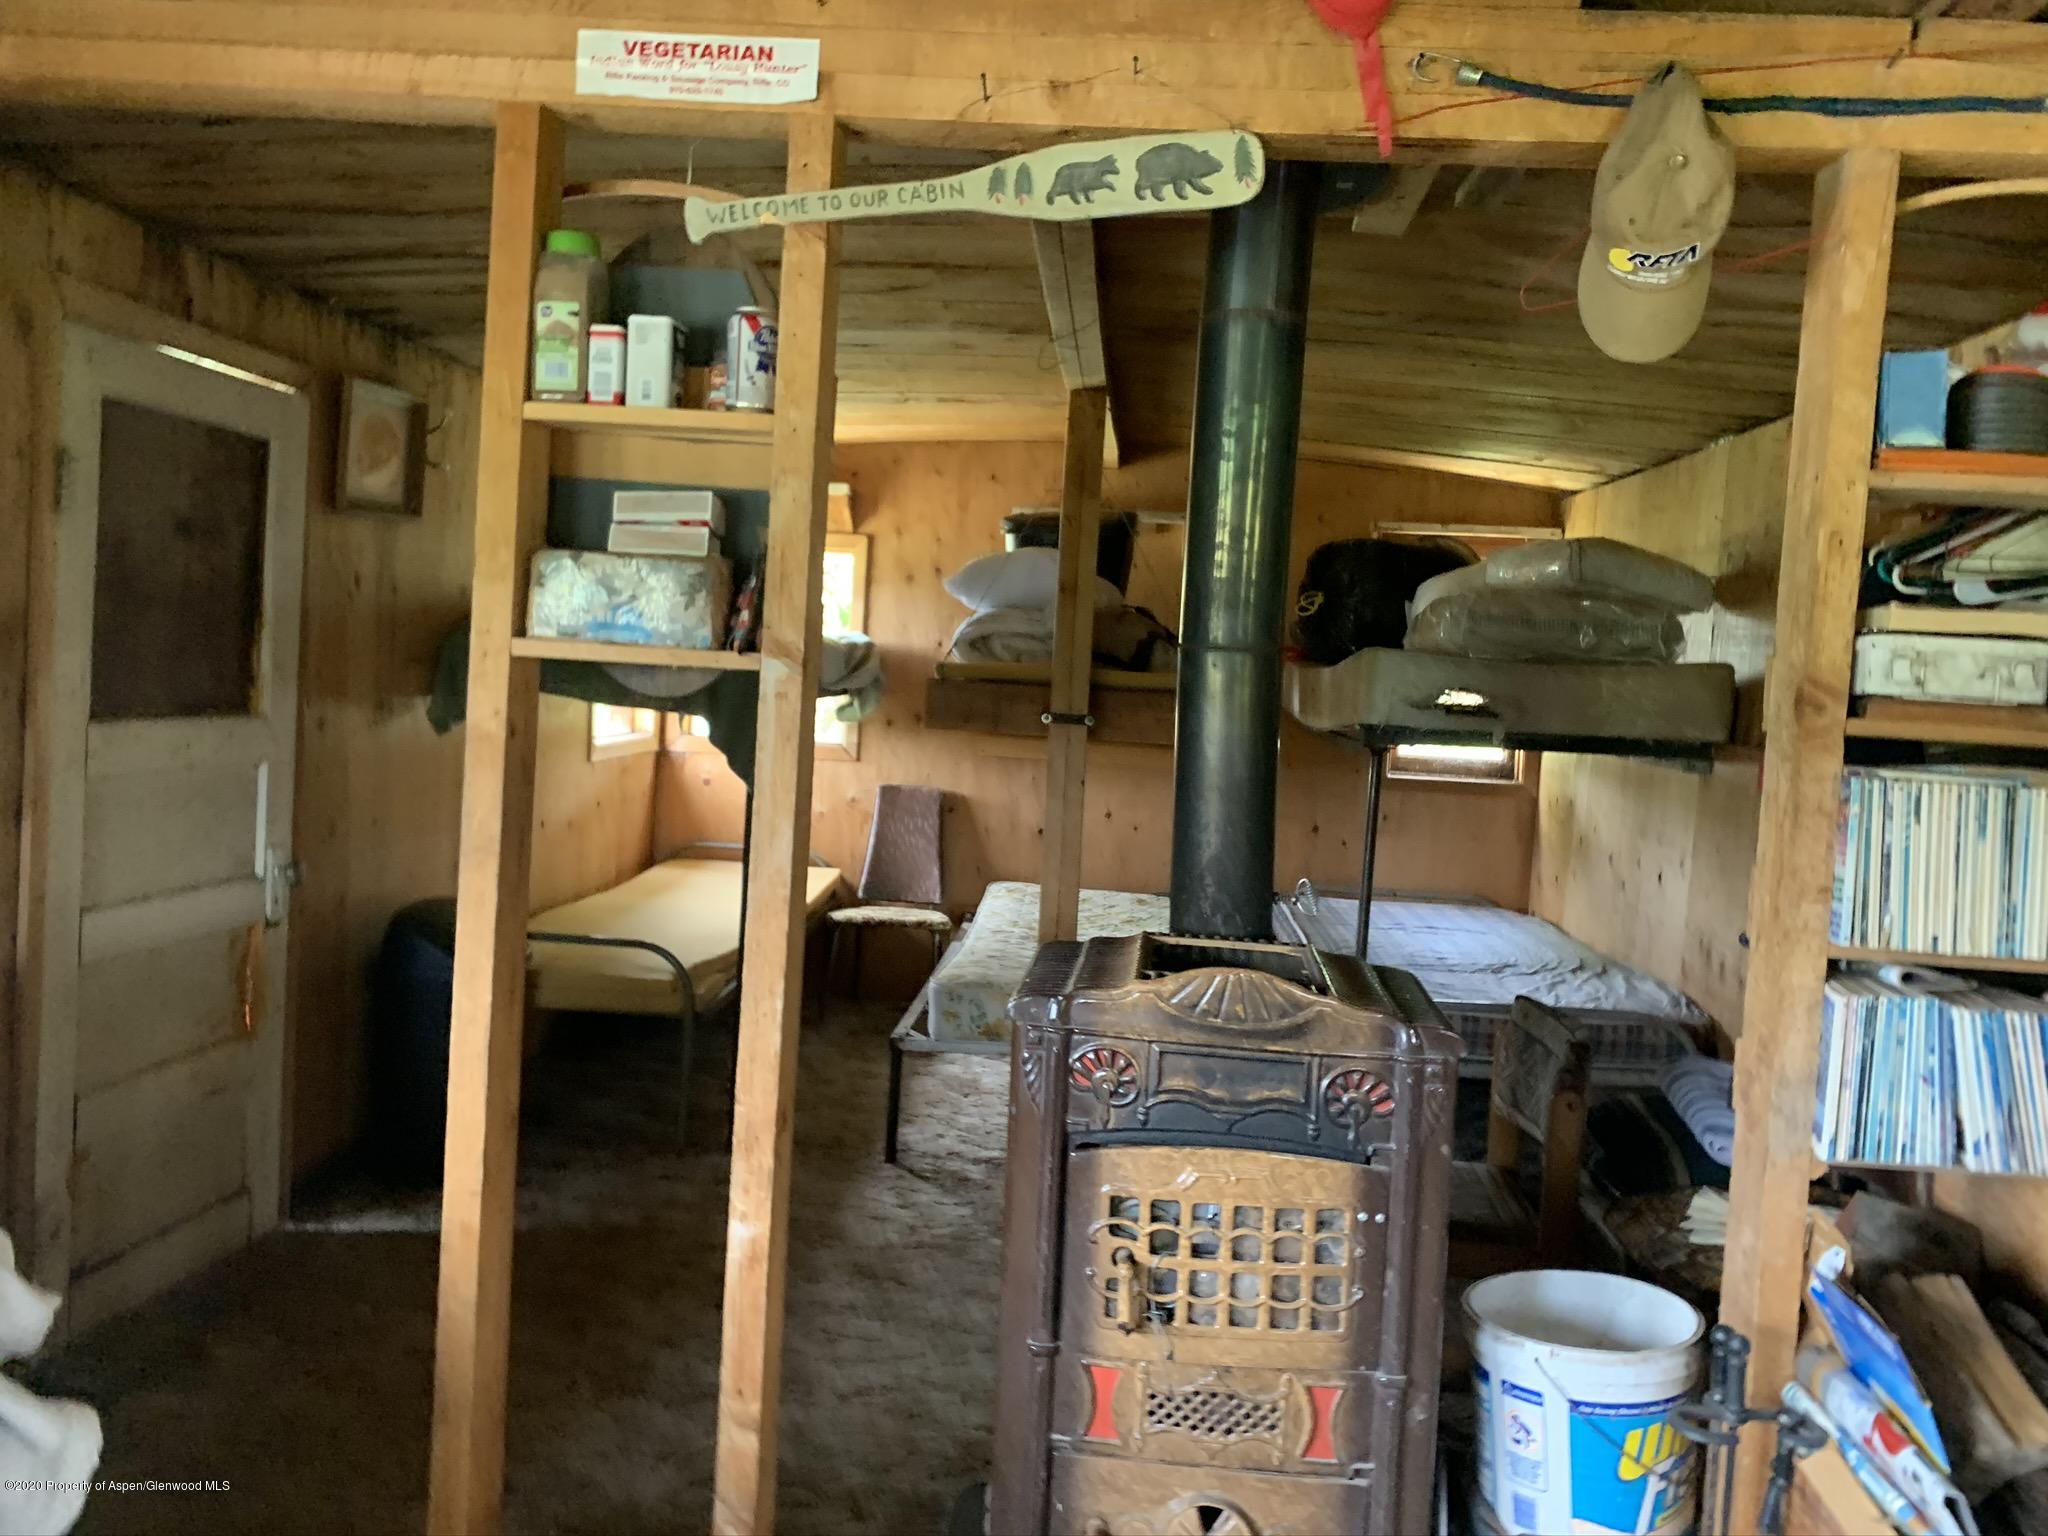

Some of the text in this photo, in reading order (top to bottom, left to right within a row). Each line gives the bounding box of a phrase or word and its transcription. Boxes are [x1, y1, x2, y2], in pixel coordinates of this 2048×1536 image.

[622, 39, 774, 63] VEGETARIAN
[706, 180, 965, 225] WELCOME TO OUR CABIN
